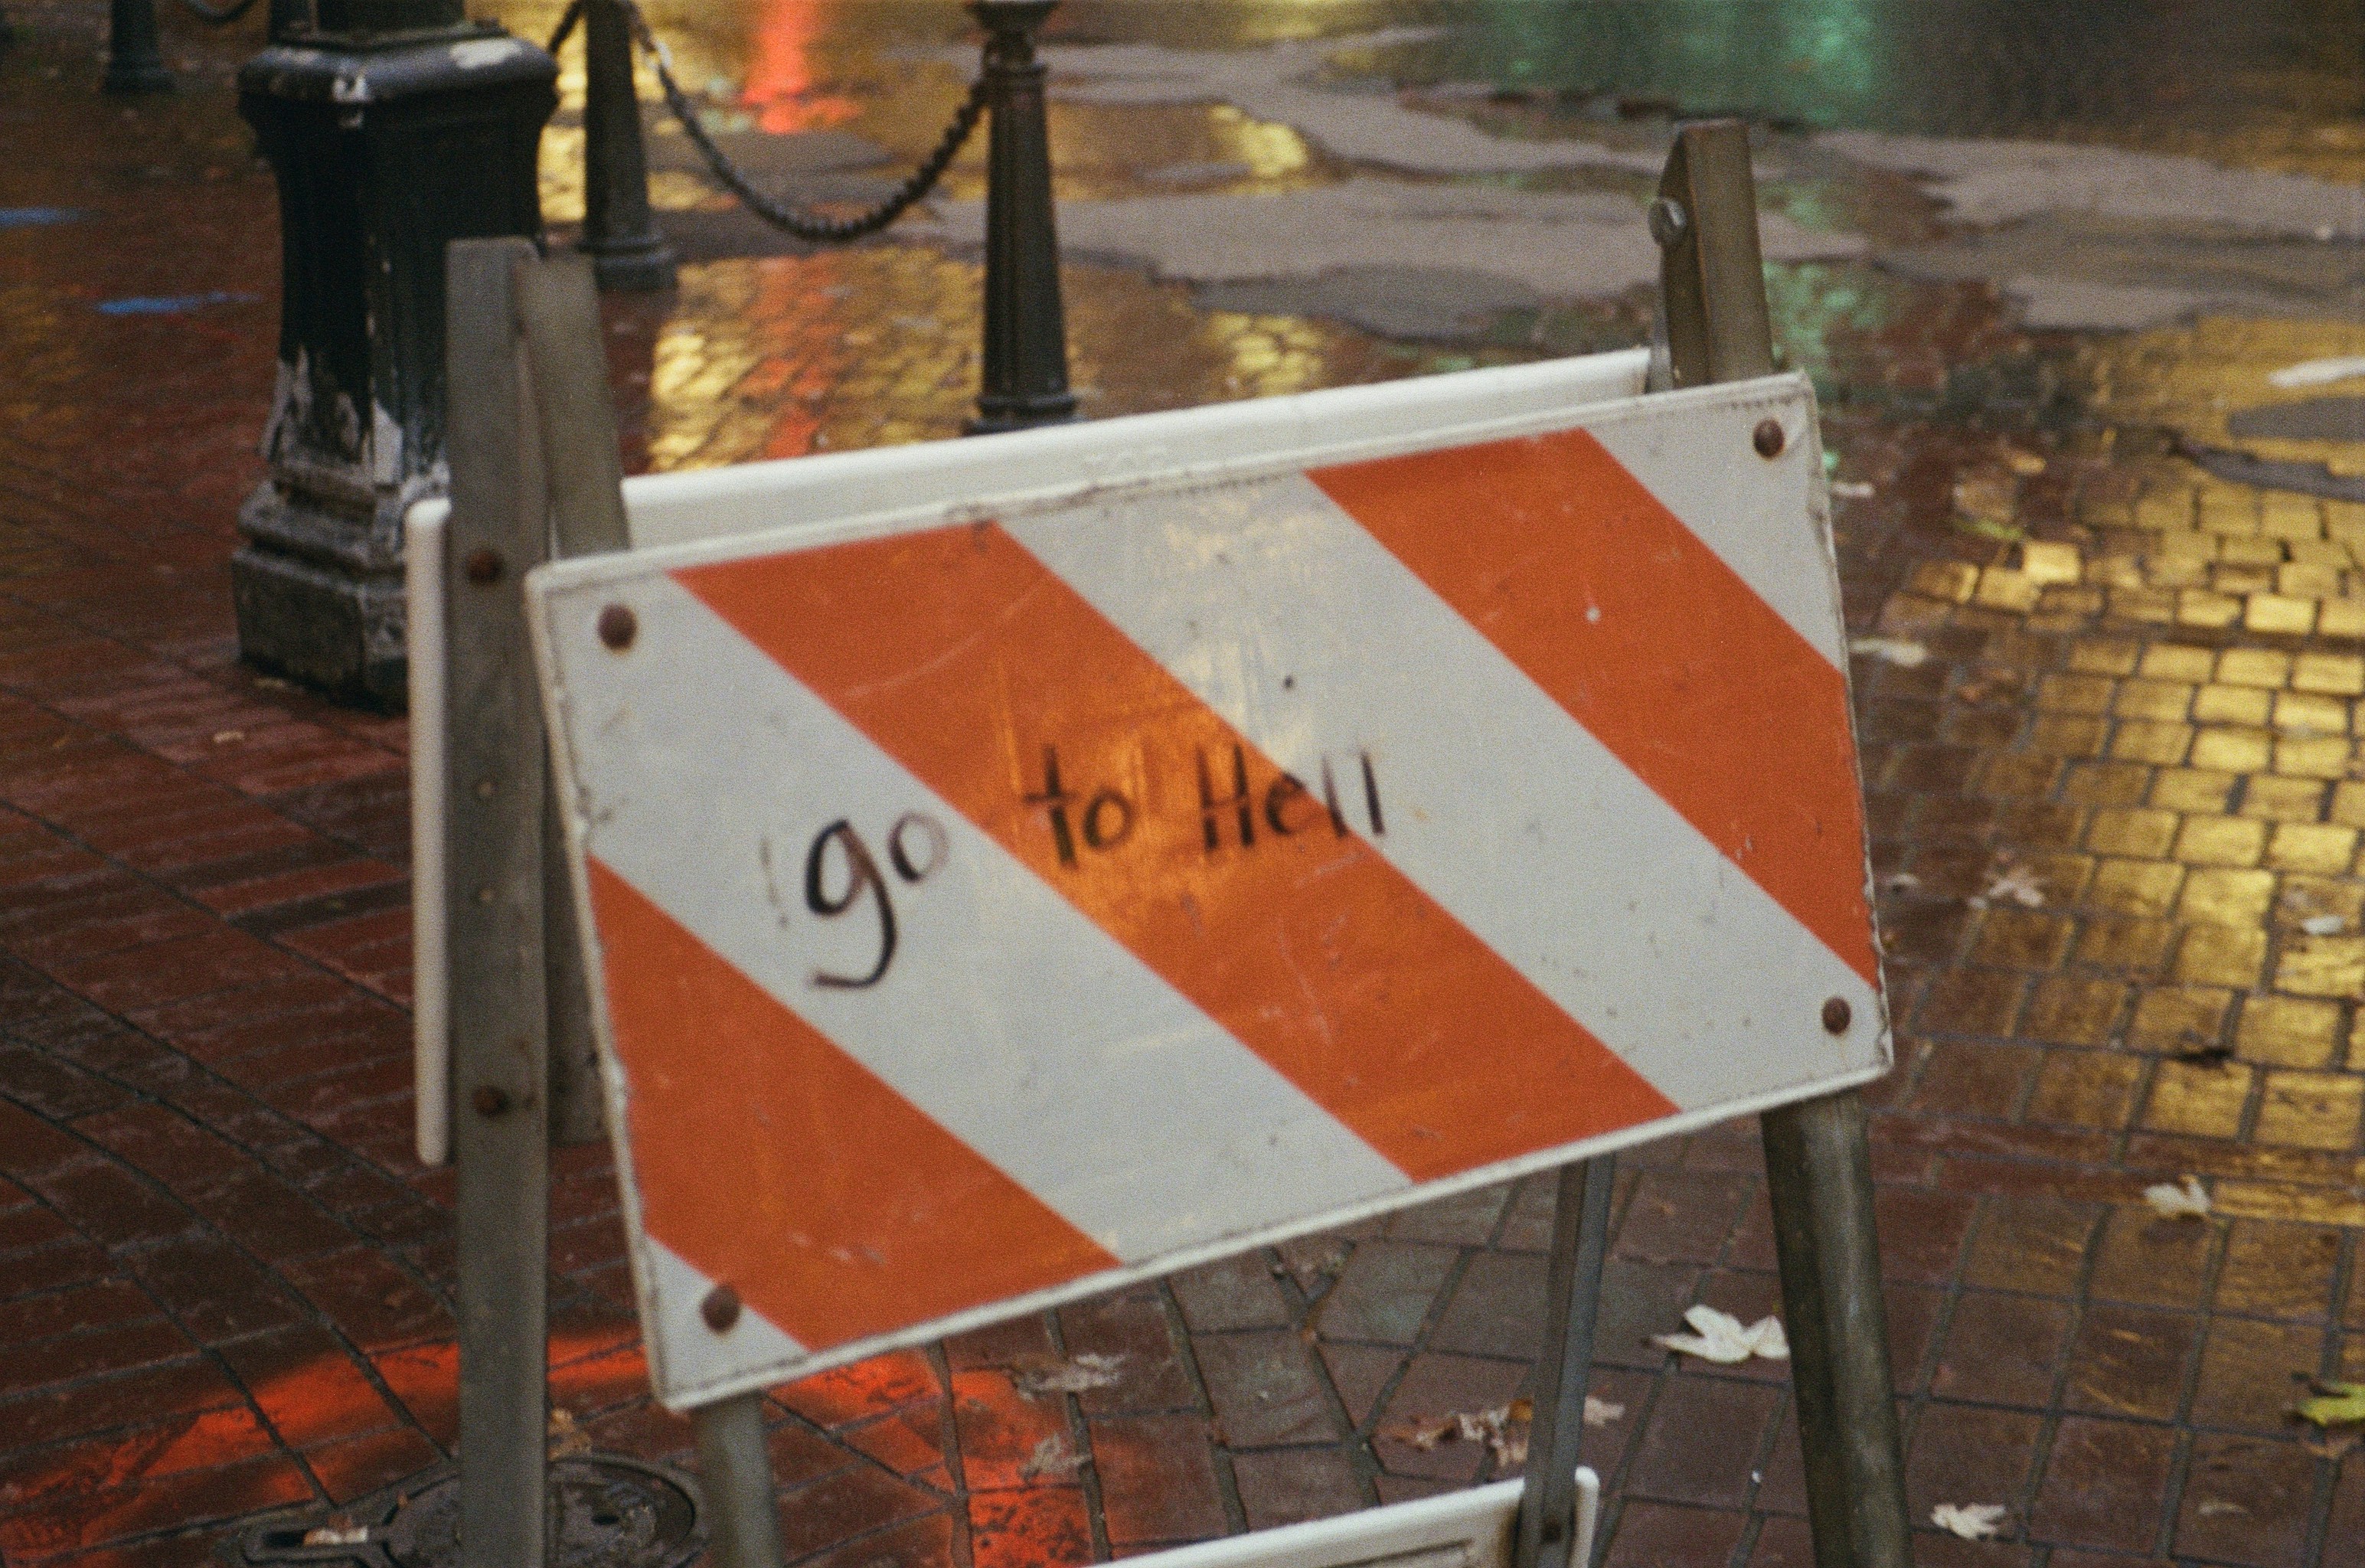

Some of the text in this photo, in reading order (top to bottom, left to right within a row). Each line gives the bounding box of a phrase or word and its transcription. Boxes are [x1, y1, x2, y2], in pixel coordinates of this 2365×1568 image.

[804, 741, 1387, 988] go to Hell
